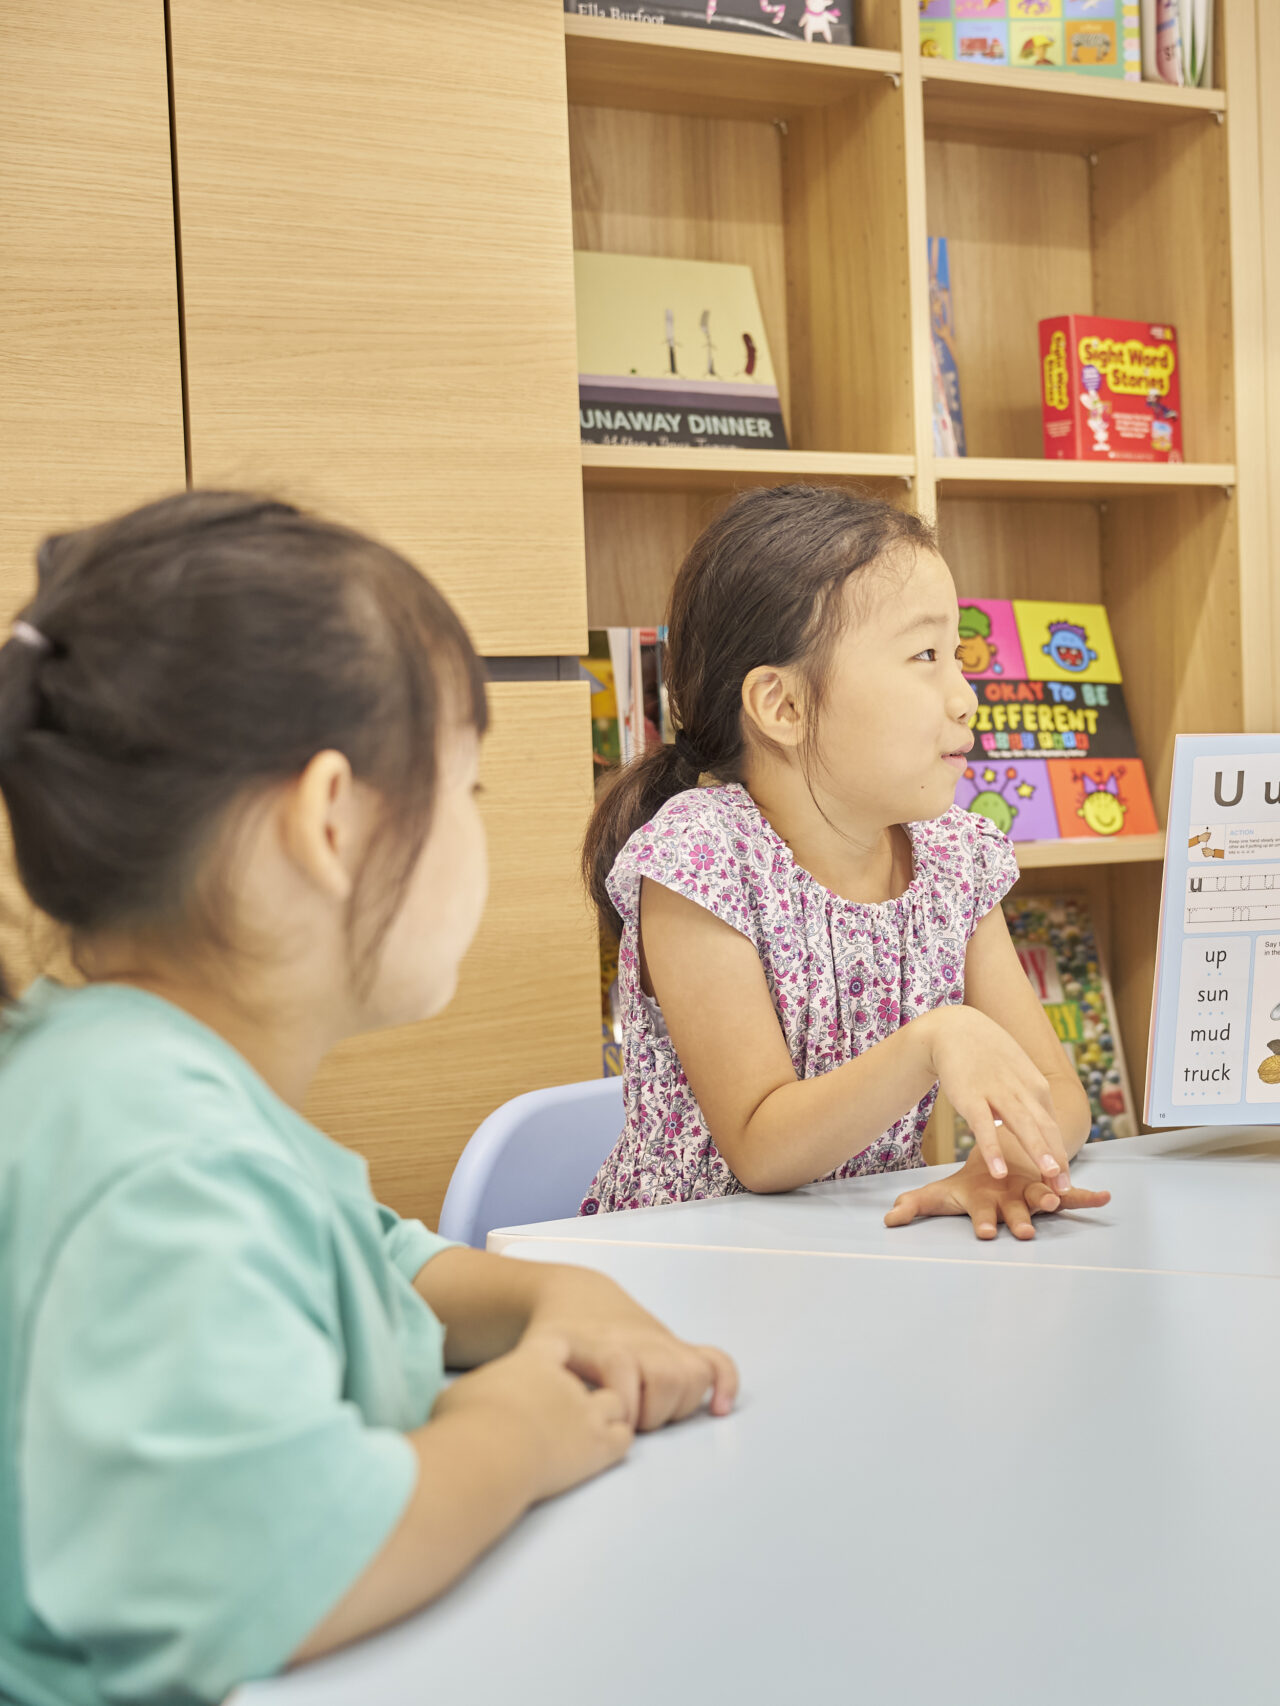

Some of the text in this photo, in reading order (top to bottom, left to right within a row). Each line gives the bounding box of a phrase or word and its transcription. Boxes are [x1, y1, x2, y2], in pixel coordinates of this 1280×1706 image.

[578, 3, 605, 18] Ella
[1084, 344, 1169, 369] Sight Word
[1112, 368, 1165, 390] Stories
[687, 414, 774, 438] DINNER
[985, 681, 1044, 702] OKAY
[1047, 682, 1076, 702] TO
[1081, 683, 1109, 706] BE
[1213, 770, 1245, 807] U
[1205, 949, 1227, 969] up
[1197, 988, 1229, 1003] sun
[1190, 1023, 1231, 1042] mud
[1184, 1062, 1231, 1082] truck
